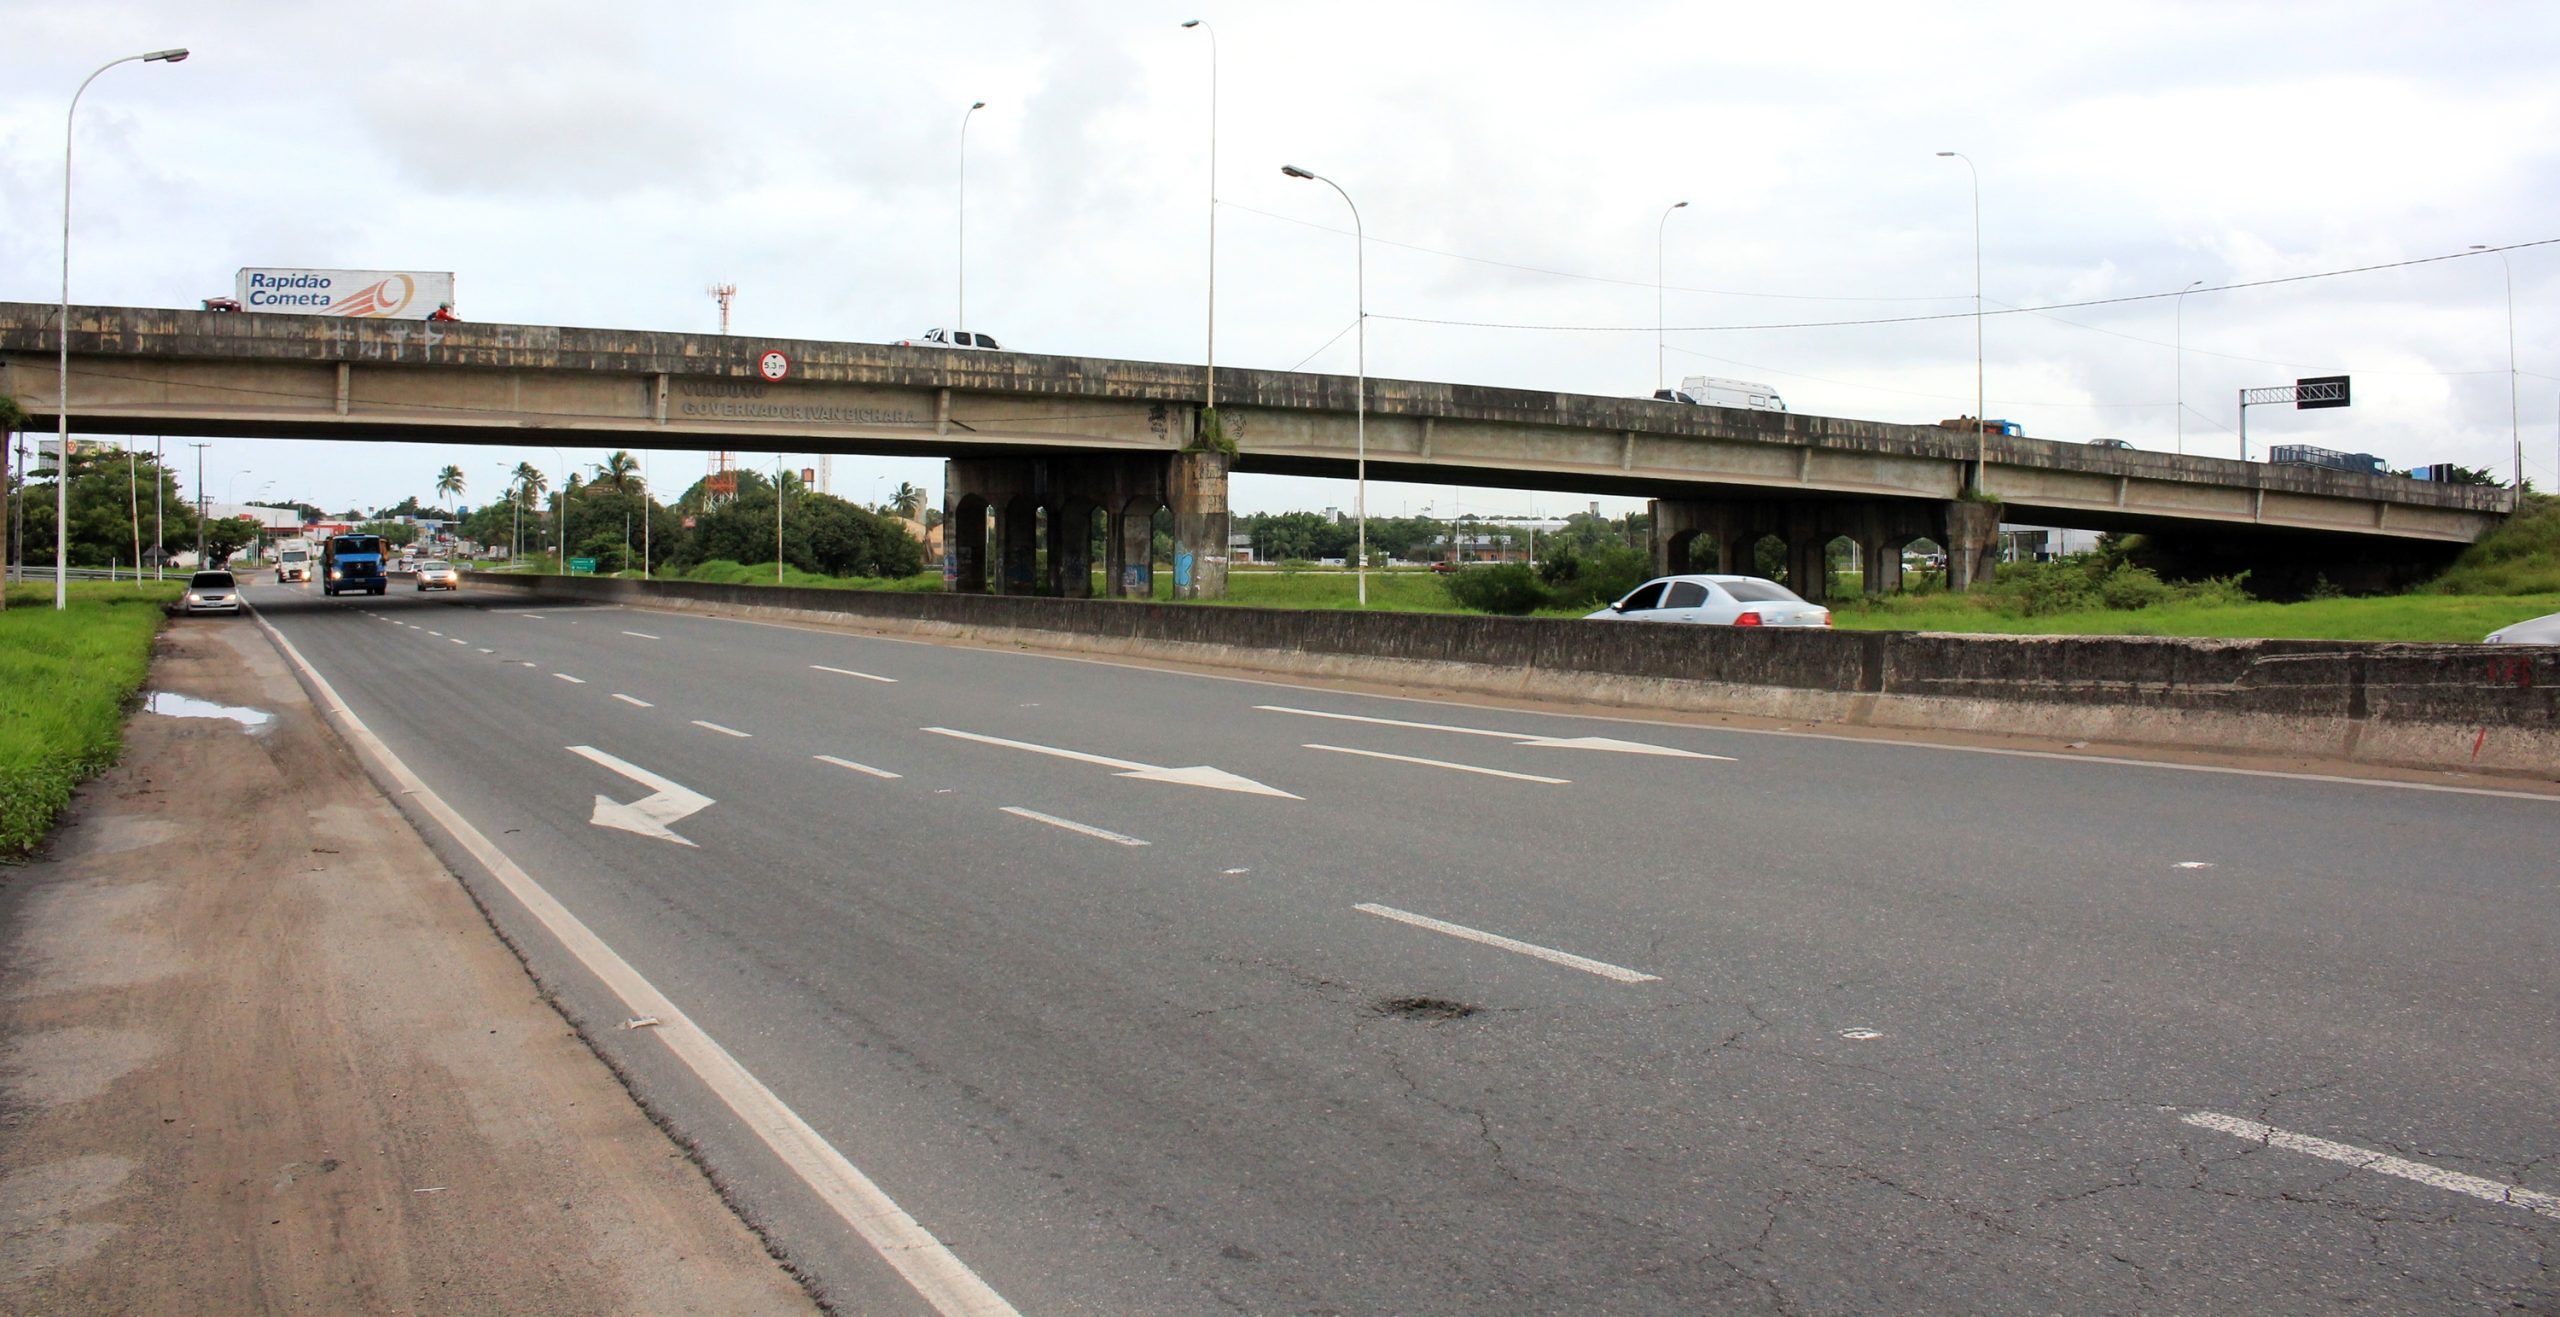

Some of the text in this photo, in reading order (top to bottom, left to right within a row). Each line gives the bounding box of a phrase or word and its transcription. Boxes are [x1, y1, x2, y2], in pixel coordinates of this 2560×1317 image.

[250, 273, 332, 292] Rapidão
[250, 290, 331, 306] Cometa
[682, 383, 767, 399] VIADUTO
[682, 402, 917, 424] GOVERNADOR IVAN BICHARA
